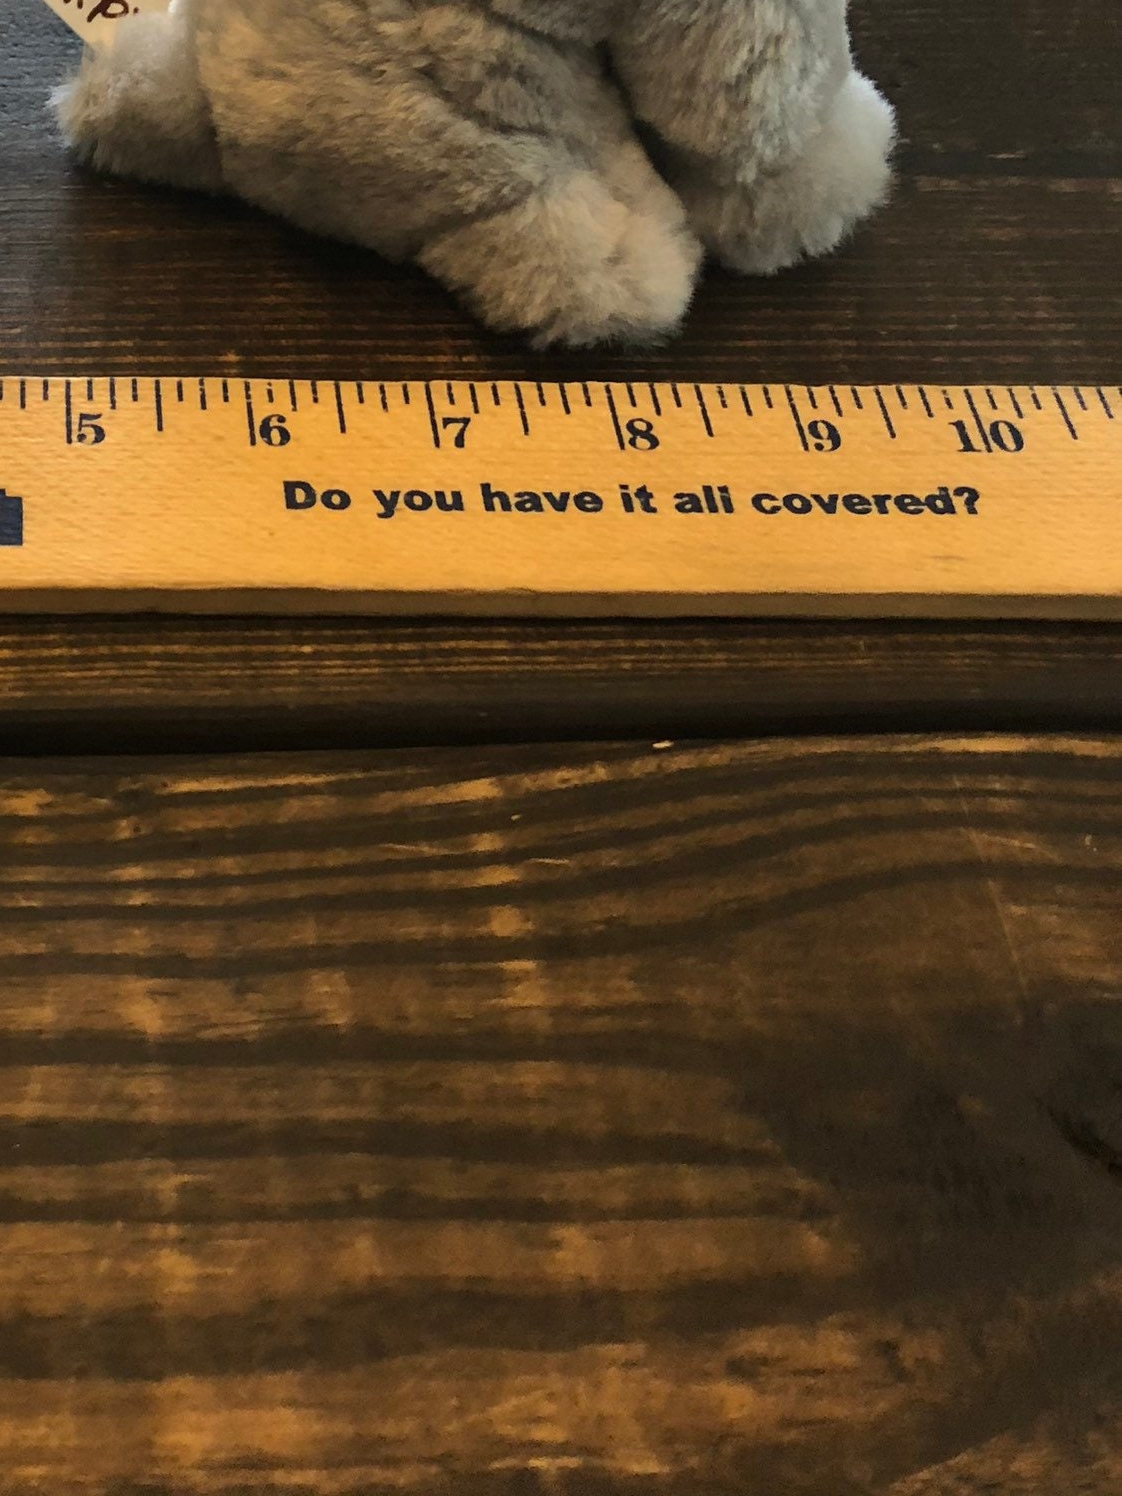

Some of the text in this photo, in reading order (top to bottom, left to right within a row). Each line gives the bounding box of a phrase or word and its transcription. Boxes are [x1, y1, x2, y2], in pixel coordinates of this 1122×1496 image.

[76, 412, 106, 445] 5
[258, 413, 291, 447] 6
[441, 416, 472, 449] 7
[625, 417, 660, 451] 8
[806, 419, 842, 453] 9
[948, 419, 1025, 454] 10
[282, 480, 980, 519] Do you have it all covered?
